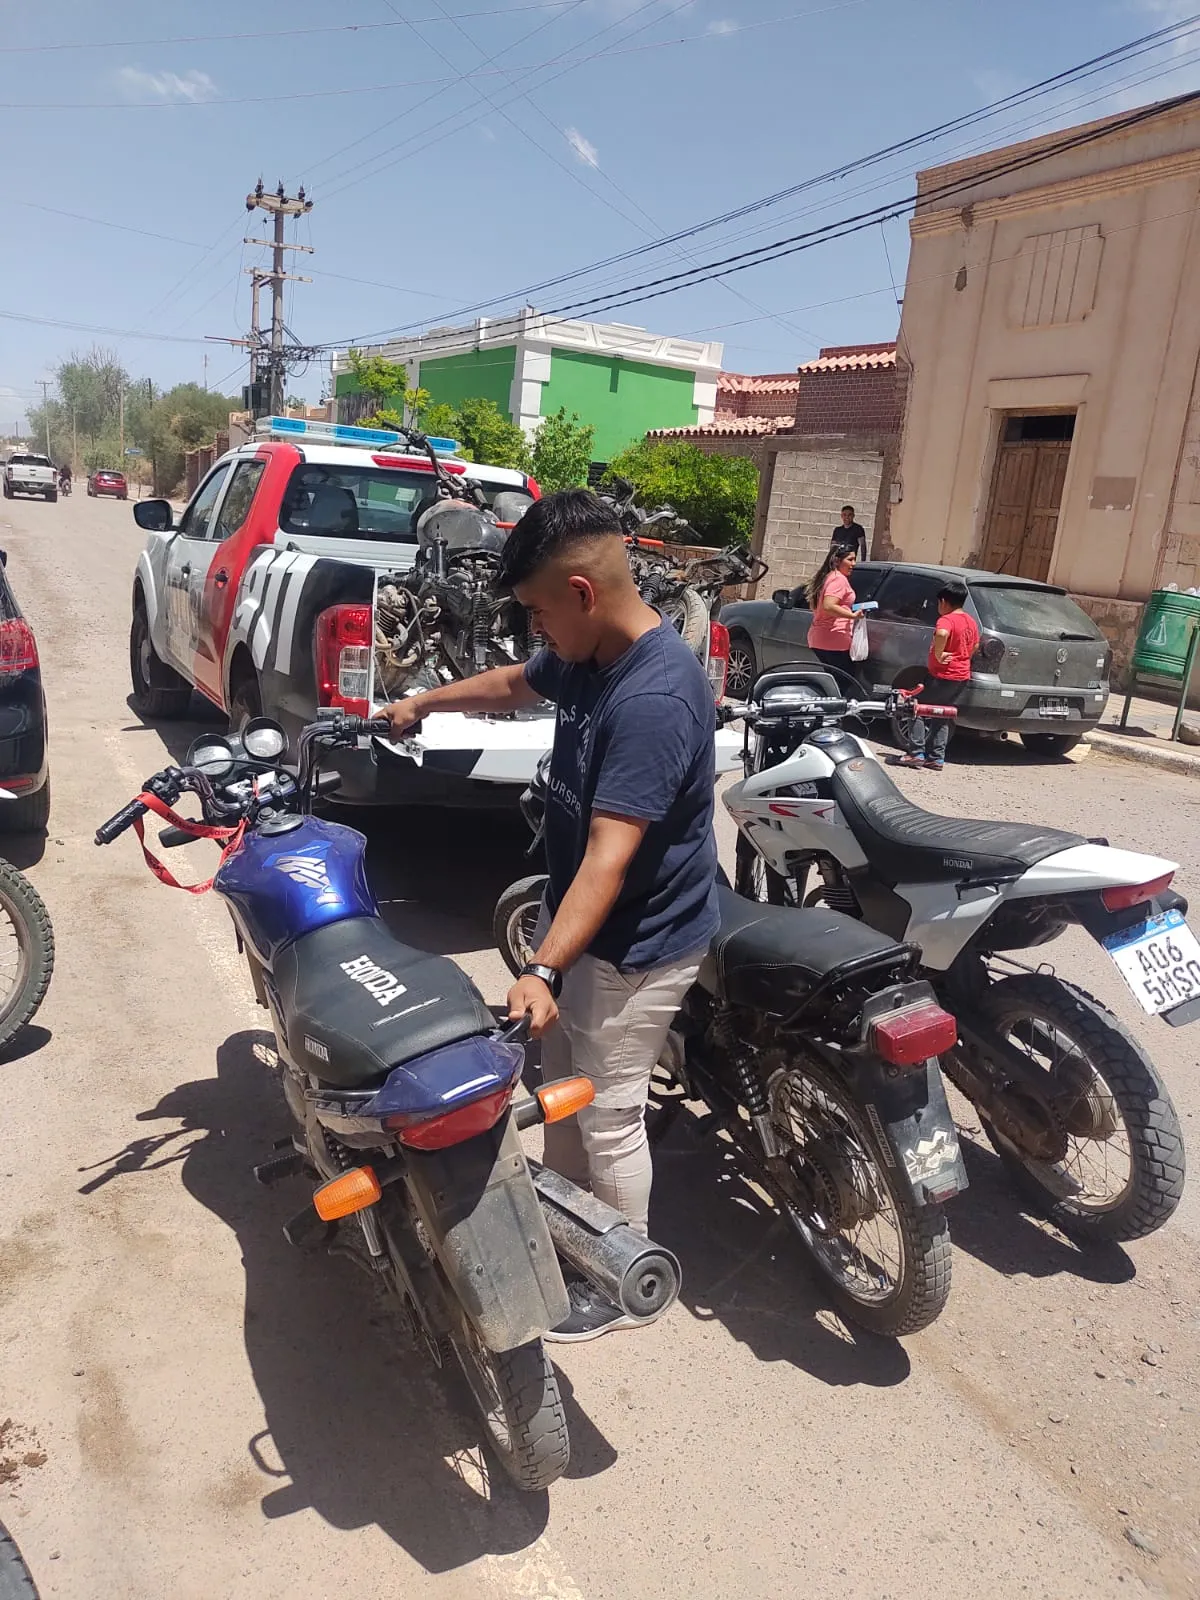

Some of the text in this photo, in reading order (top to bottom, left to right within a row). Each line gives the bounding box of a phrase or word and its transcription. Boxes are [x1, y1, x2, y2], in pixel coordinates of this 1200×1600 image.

[235, 549, 320, 675] 911
[943, 857, 972, 869] HONDA
[1135, 936, 1183, 976] A06
[339, 954, 408, 1007] HONDA
[303, 1036, 329, 1062] HONDA
